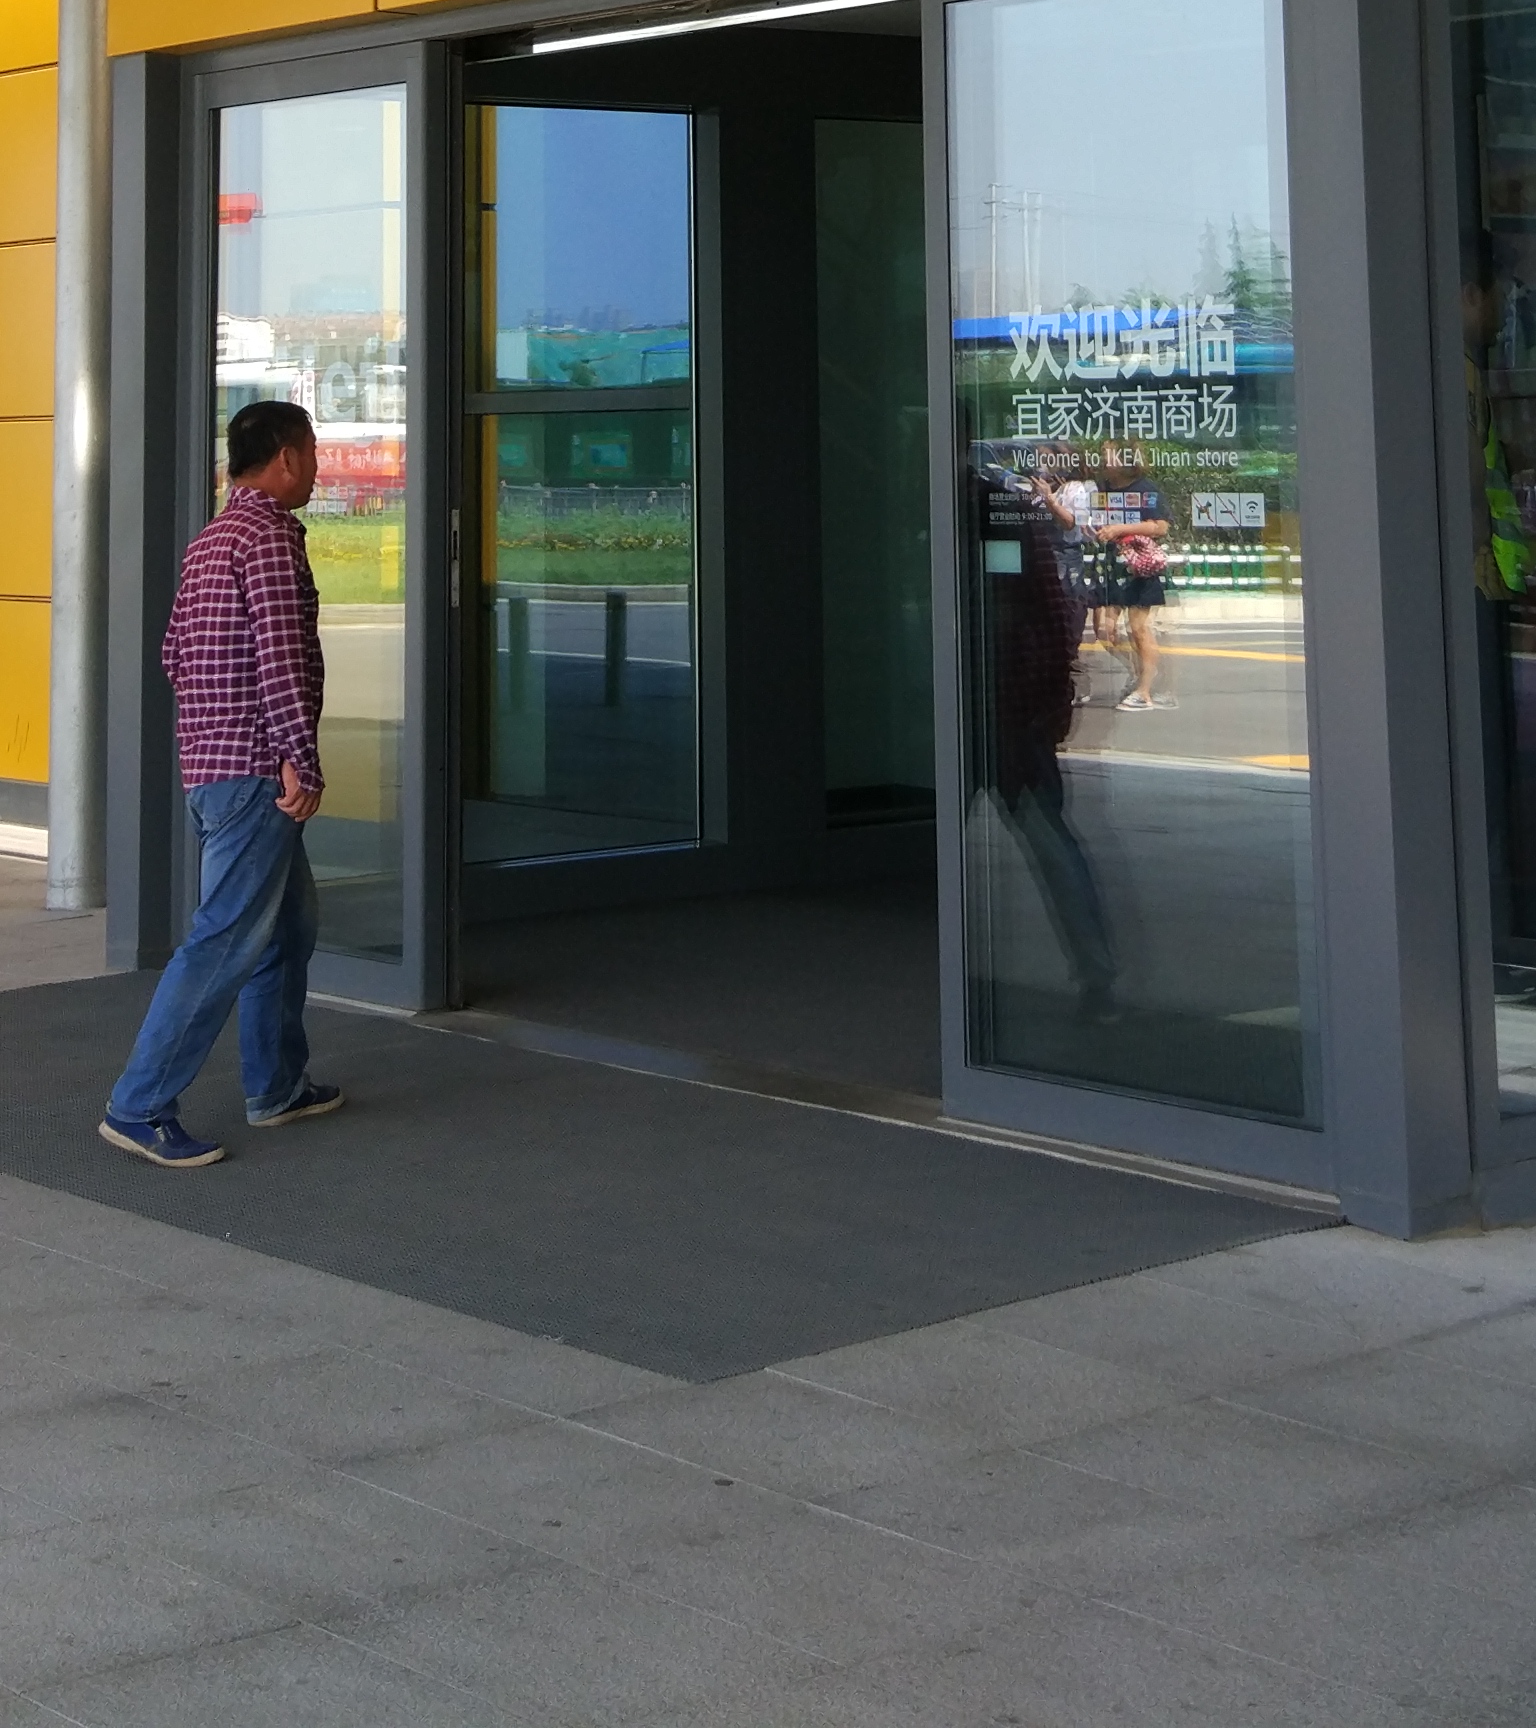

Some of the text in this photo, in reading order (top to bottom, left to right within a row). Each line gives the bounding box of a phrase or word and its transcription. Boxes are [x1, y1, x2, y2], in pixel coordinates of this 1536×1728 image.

[1009, 294, 1235, 381] 欢迎光临
[1012, 384, 1237, 440] 宜家济南商场
[1012, 448, 1239, 469] Welcome to IKEA Jinan store
